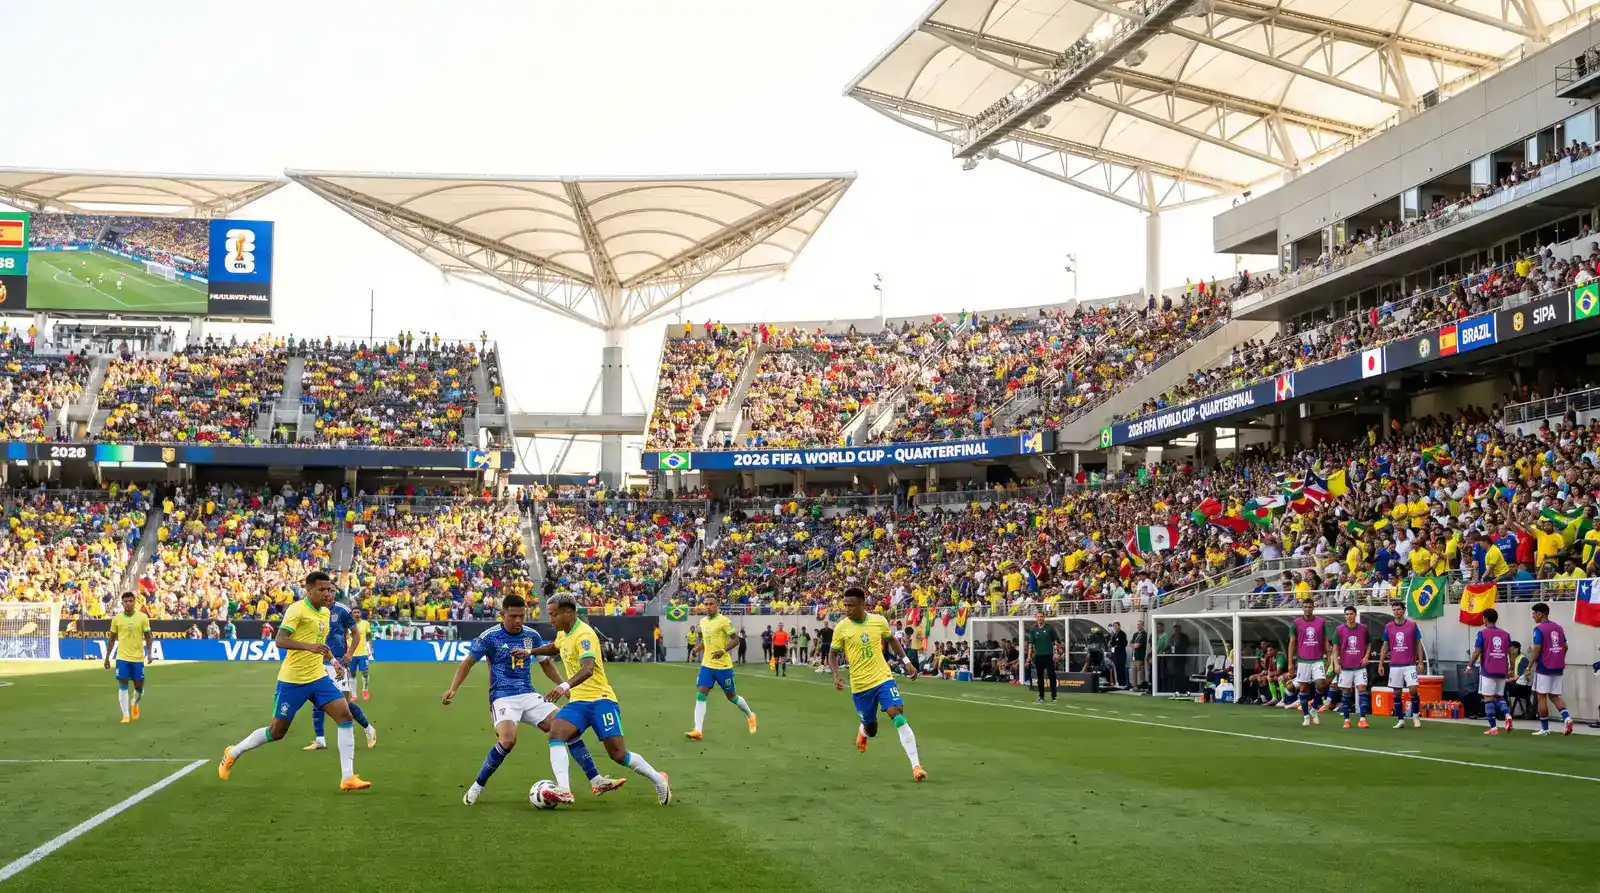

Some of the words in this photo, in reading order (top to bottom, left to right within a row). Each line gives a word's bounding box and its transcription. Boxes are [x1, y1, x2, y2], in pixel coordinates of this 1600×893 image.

[1533, 304, 1556, 324] SIPA
[1462, 323, 1492, 345] BRAZIL
[1143, 418, 1157, 433] FIFA
[1156, 409, 1181, 430] WORLD
[1181, 406, 1196, 423] CUP
[1200, 390, 1255, 420] QUARTERFINAL
[50, 446, 87, 458] 2026
[733, 453, 770, 466] 2026
[772, 452, 802, 465] FIFA
[805, 451, 855, 464] WORLD
[857, 449, 885, 462] CUP
[894, 442, 989, 463] QUARTERFINAL
[93, 640, 164, 660] VA
[218, 640, 280, 660] VISA
[602, 712, 614, 726] 19
